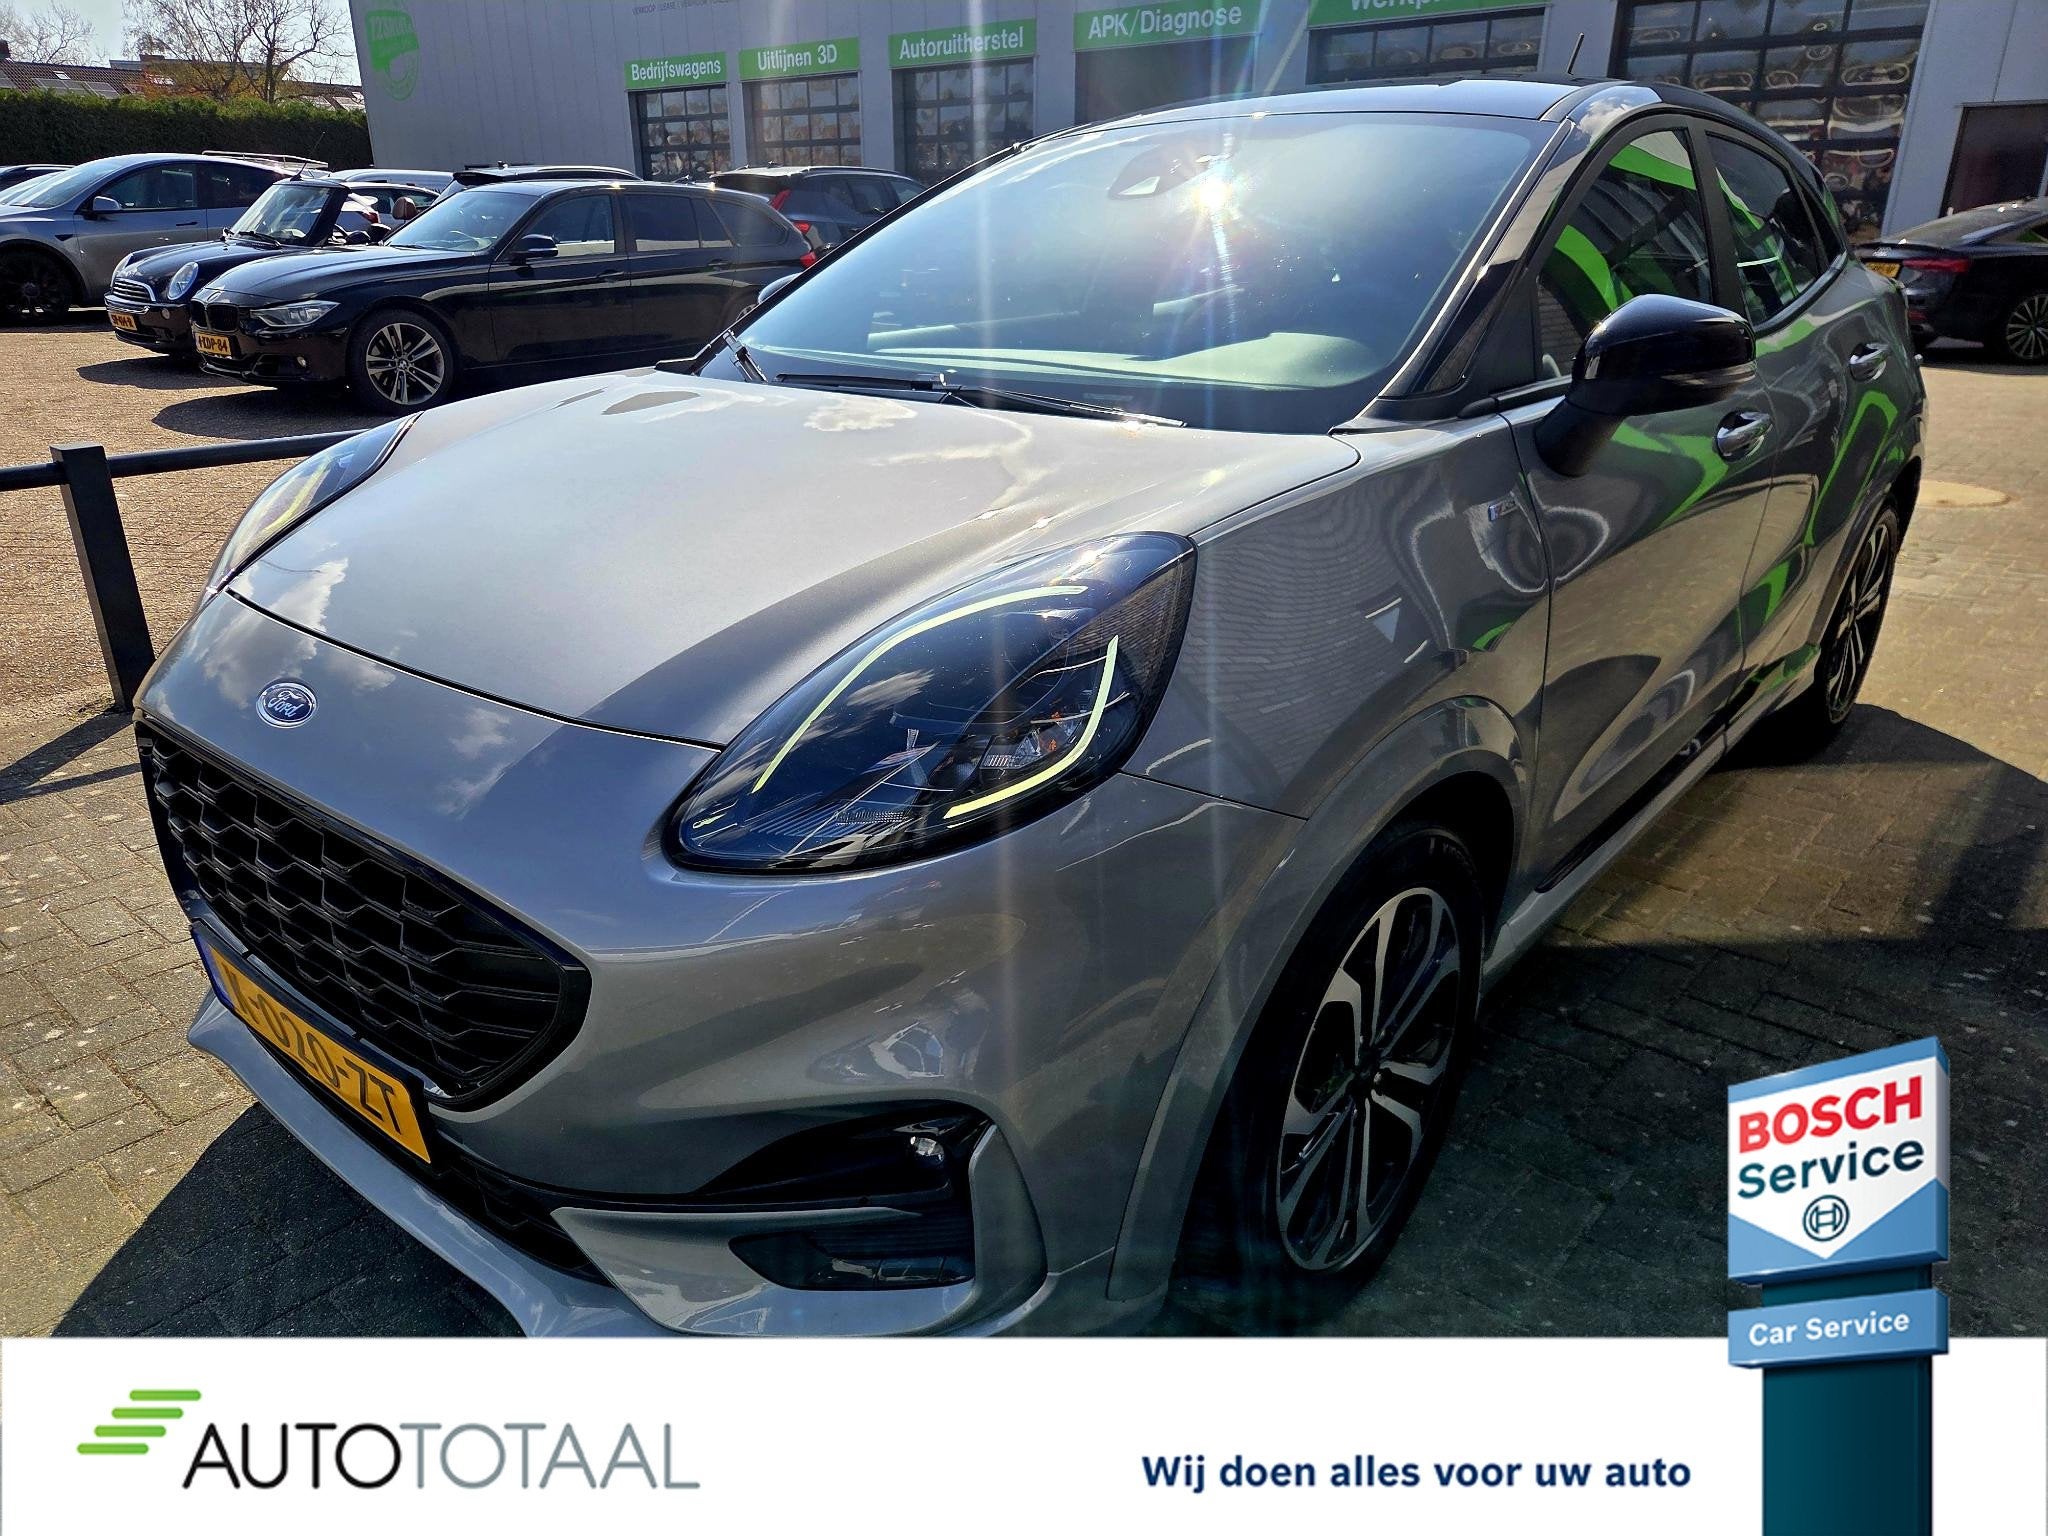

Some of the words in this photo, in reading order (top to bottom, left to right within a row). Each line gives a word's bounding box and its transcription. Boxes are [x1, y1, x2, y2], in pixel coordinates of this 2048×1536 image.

[1088, 6, 1242, 39] APK/Diagnose
[899, 26, 1024, 60] Autoruitherstel
[631, 60, 722, 82] Bedrijfswagens
[757, 49, 812, 72] Uitlijnen
[817, 44, 838, 65] 3D
[267, 691, 305, 718] Ford
